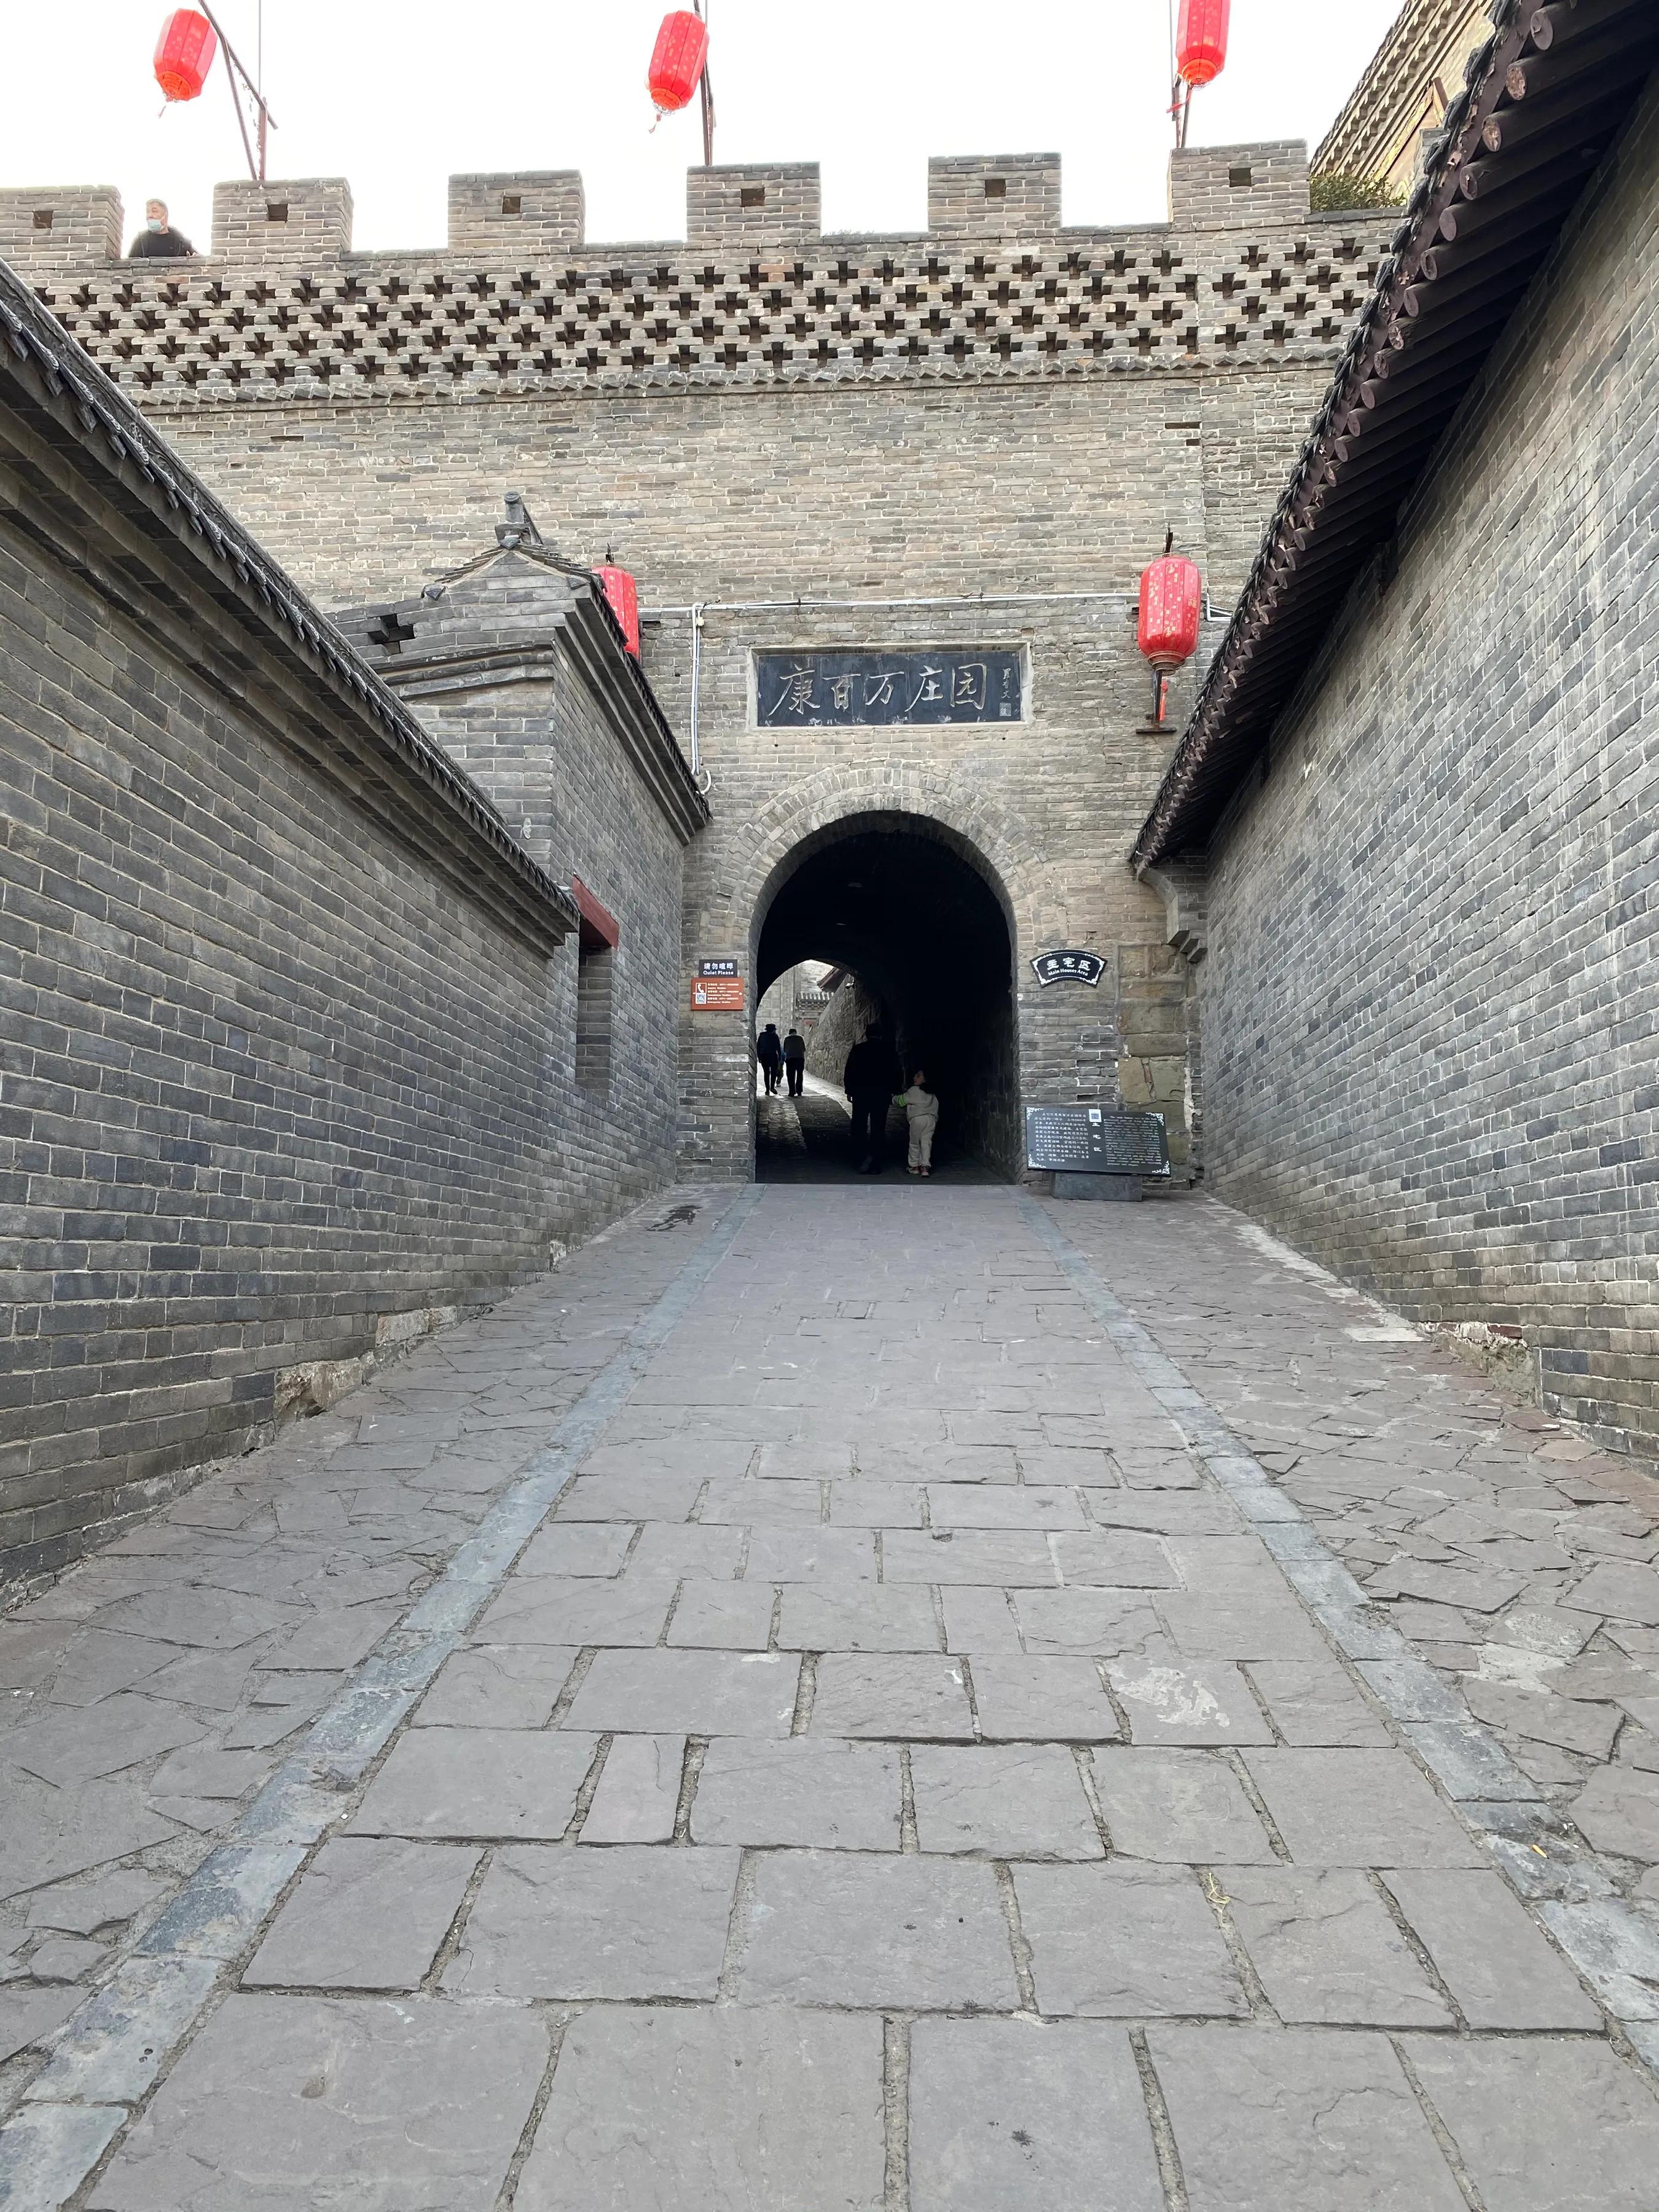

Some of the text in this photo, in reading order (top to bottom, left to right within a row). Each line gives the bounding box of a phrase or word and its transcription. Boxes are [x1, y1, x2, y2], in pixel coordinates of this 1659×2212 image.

[768, 662, 987, 716] 康百万庄园
[1046, 957, 1091, 971] 主宅区
